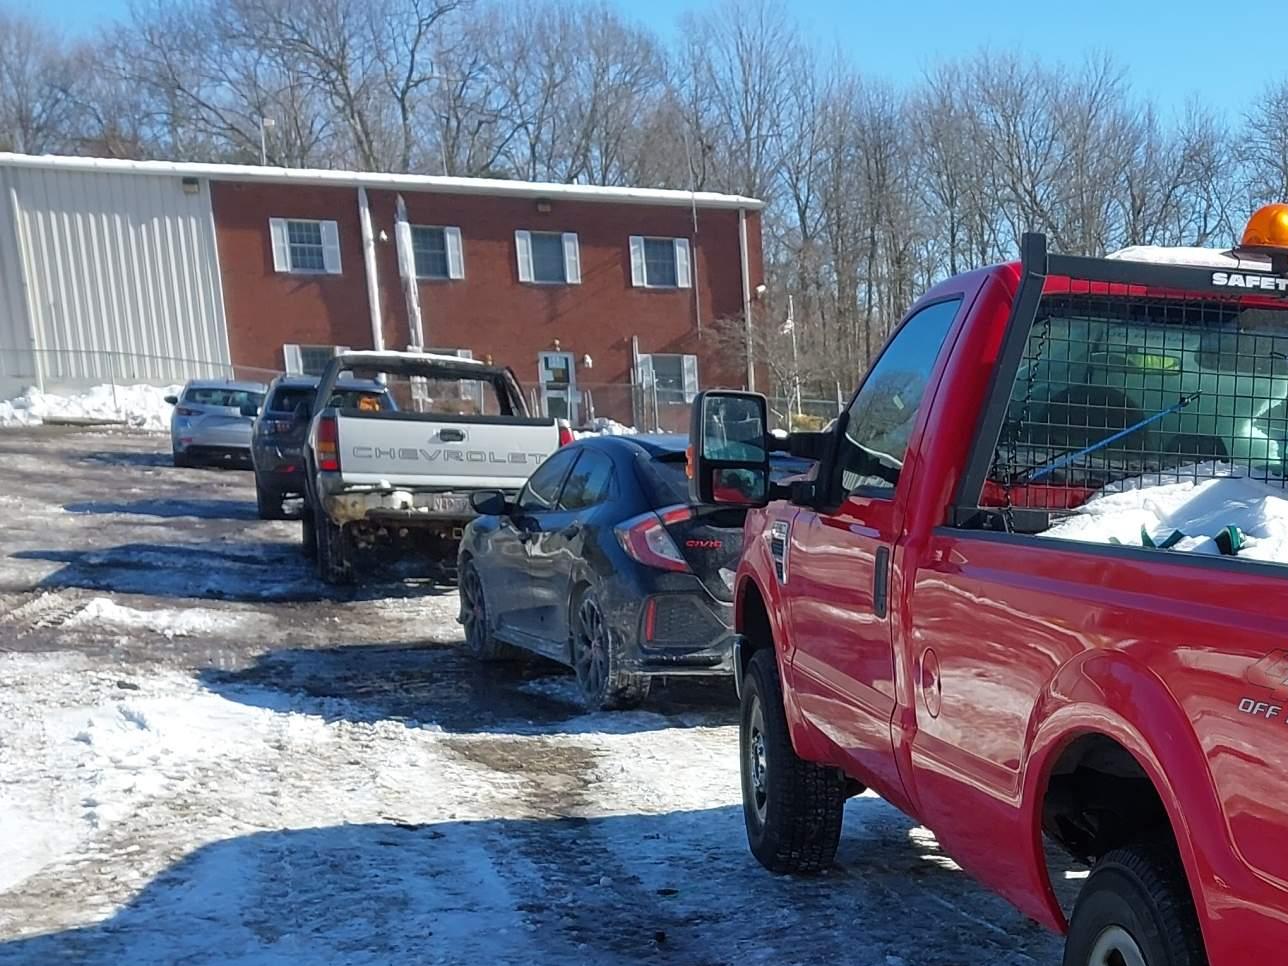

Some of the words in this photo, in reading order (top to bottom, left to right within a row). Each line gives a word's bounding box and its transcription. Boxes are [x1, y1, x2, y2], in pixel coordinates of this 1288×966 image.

[352, 447, 548, 464] CHEVROLET
[686, 540, 722, 549] CIVIC
[1238, 698, 1282, 719] OFF
